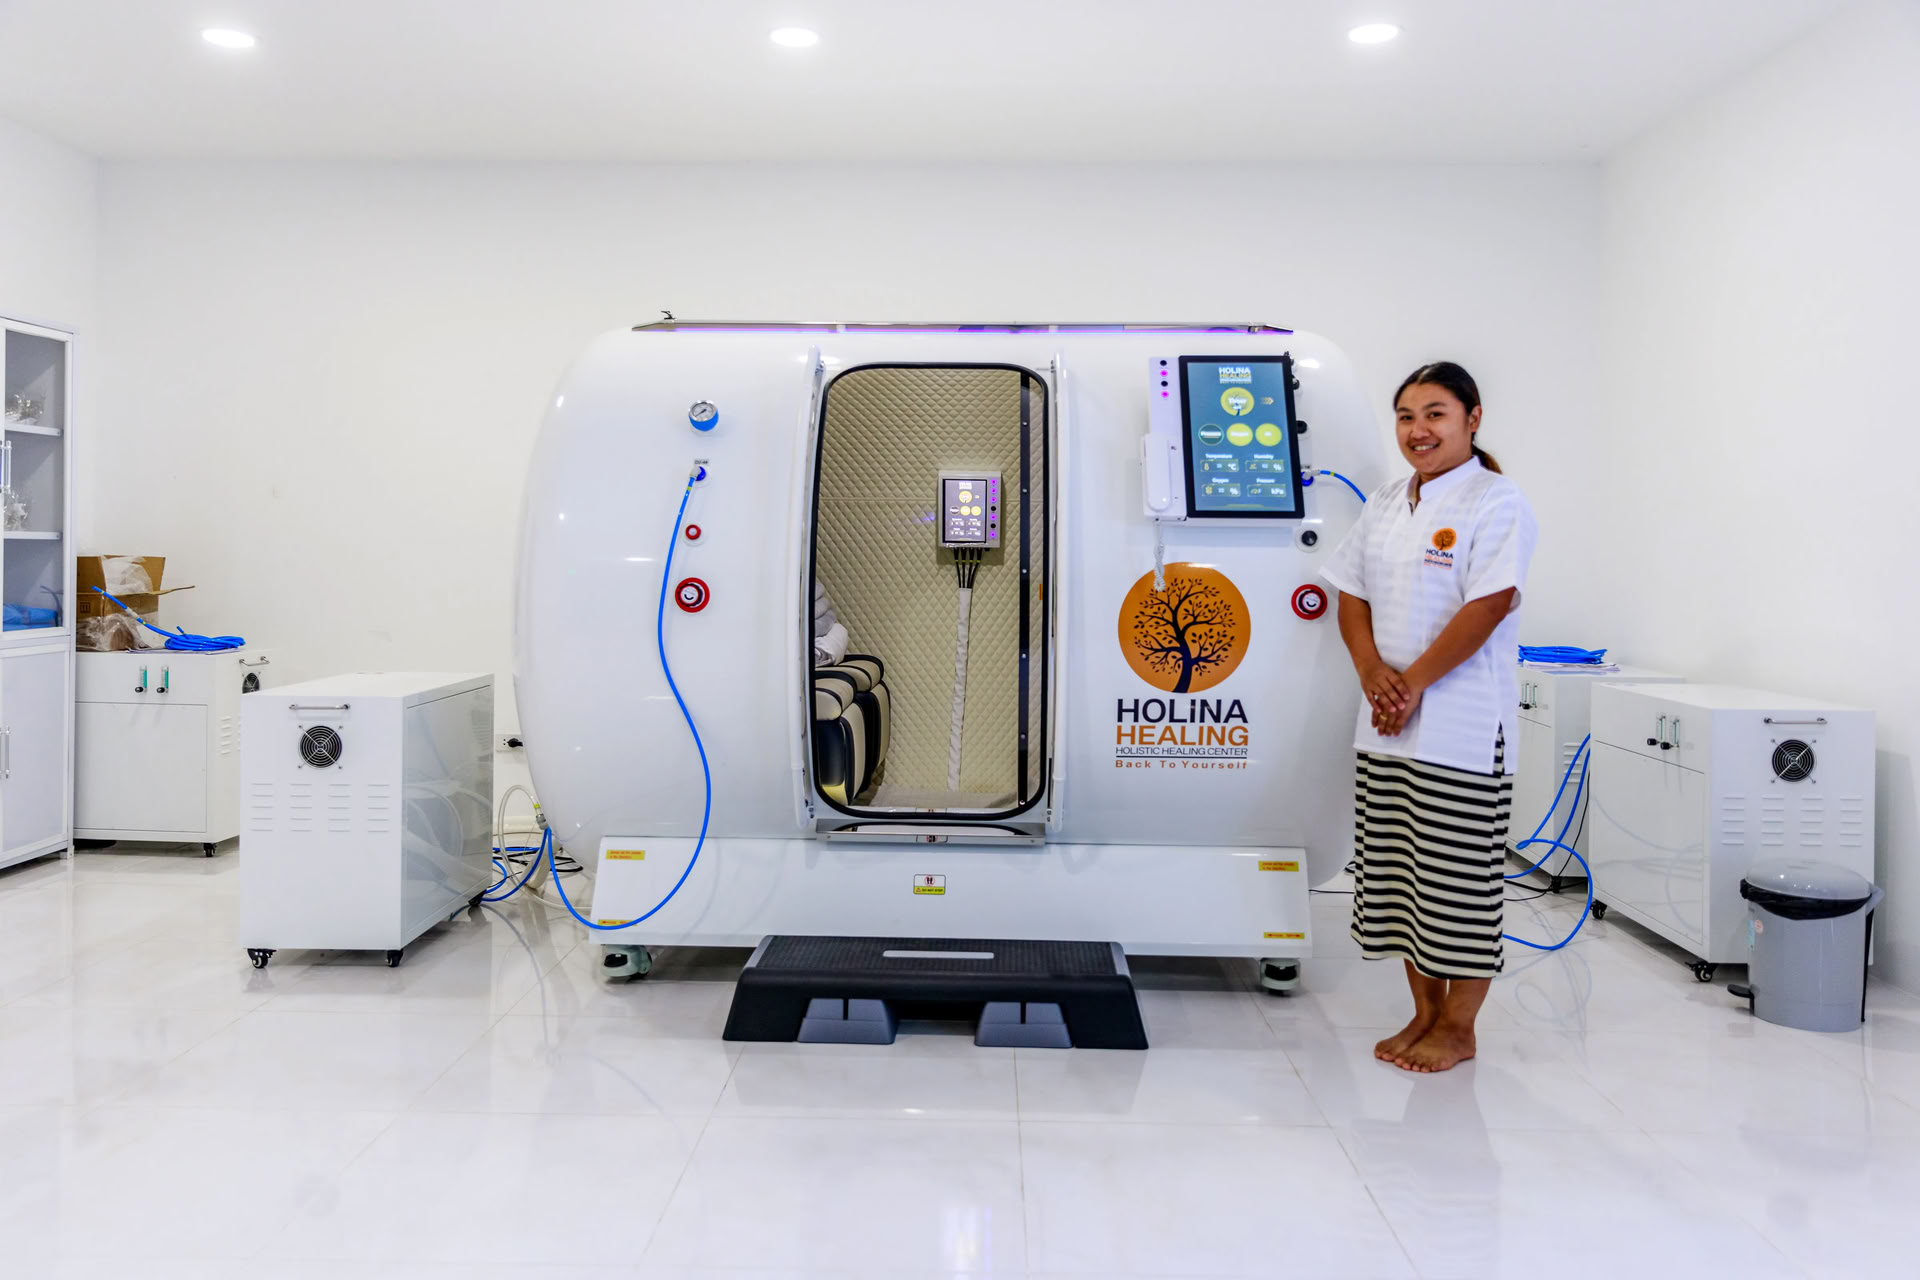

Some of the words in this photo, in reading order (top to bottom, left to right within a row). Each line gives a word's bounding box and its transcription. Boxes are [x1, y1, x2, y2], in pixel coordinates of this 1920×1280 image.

[1115, 724, 1249, 746] HEALING
[1115, 746, 1160, 755] HOLISTIC
[1161, 747, 1206, 756] HEALING
[1207, 747, 1248, 756] CENTER
[1115, 759, 1151, 768] Back
[1160, 760, 1176, 769] To
[1181, 760, 1248, 769] Yourself
